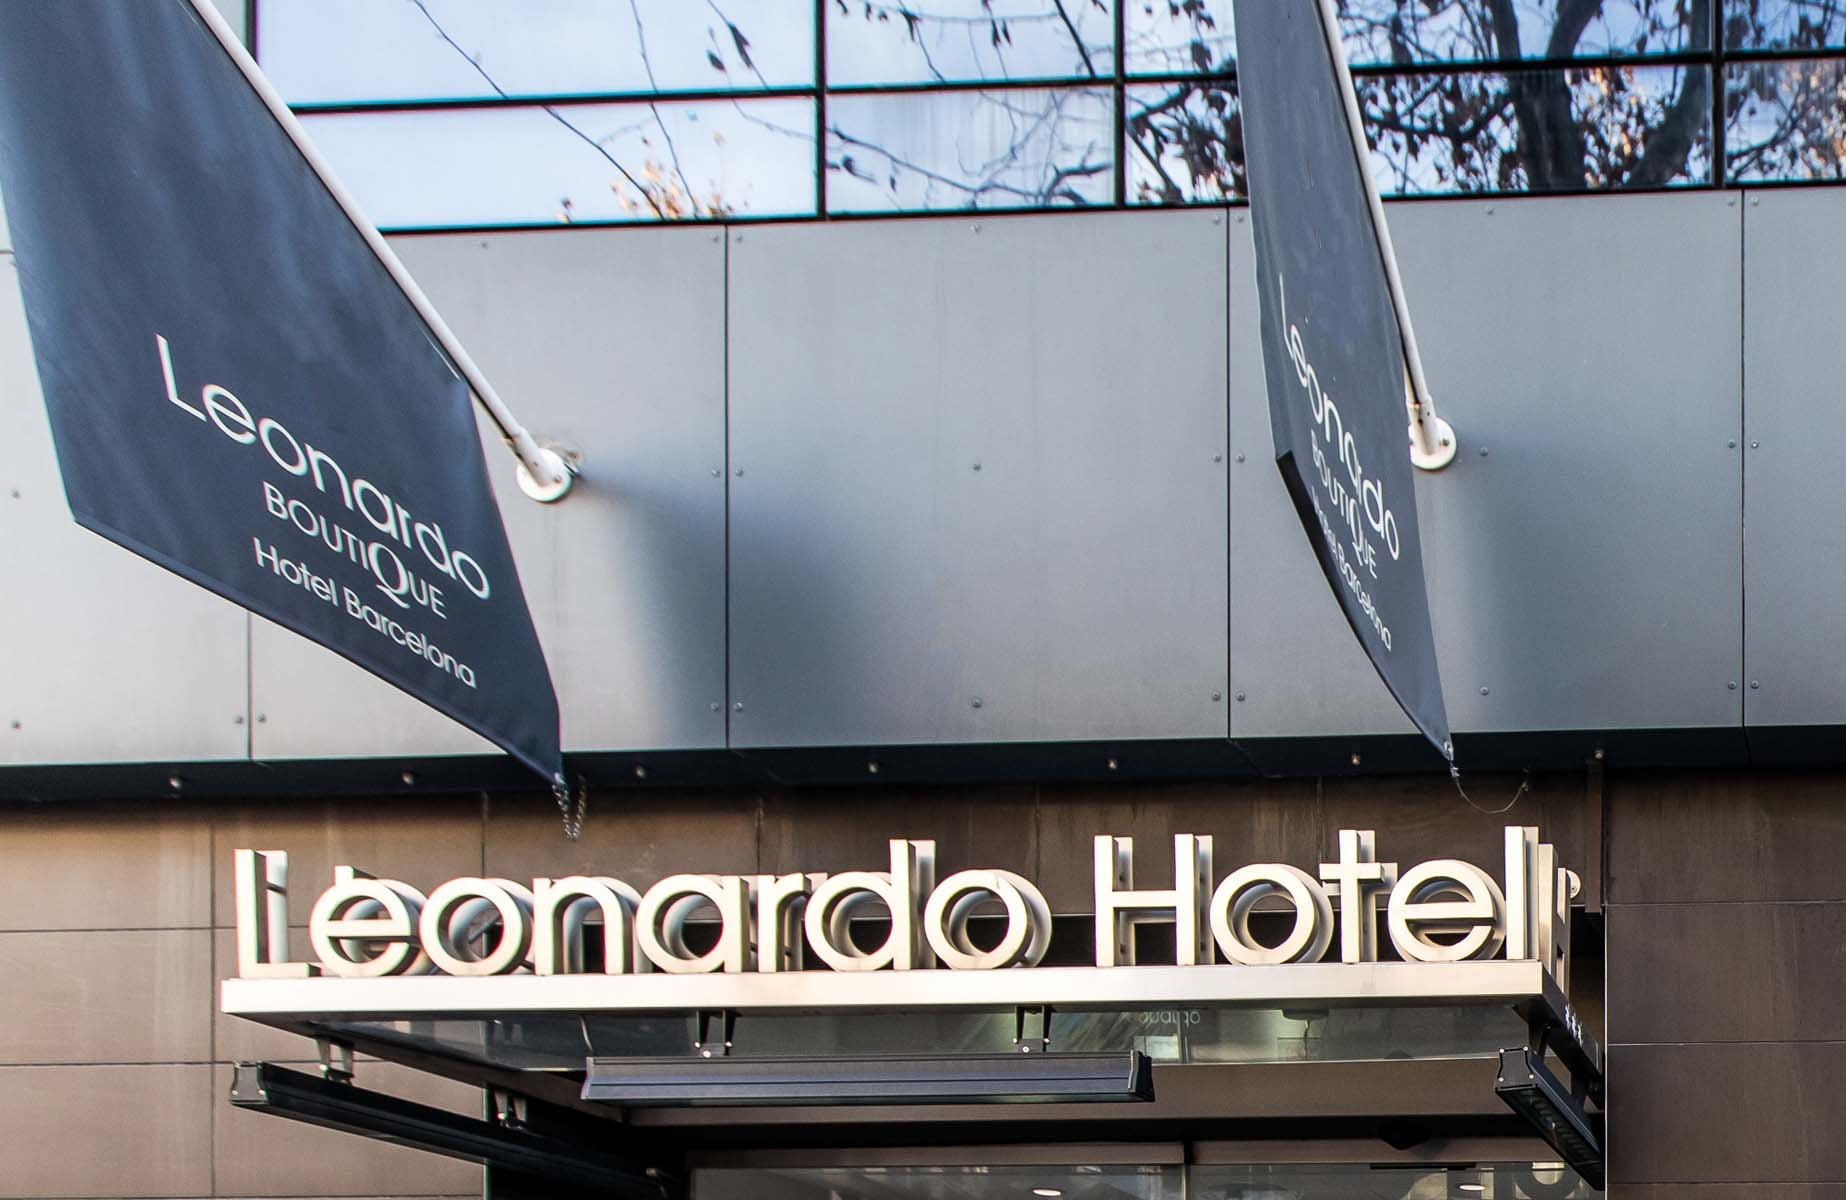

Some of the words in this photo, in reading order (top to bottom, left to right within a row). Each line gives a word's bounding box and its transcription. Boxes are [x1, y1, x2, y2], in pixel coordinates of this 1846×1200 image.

[155, 332, 491, 601] Leonardo
[1278, 271, 1400, 561] Leonardo
[262, 480, 449, 621] BOUTIQUE
[1310, 428, 1378, 580] BOUTIQUE
[253, 536, 338, 607] Hotel
[344, 585, 478, 690] Barcelona
[234, 838, 1030, 979] Leonardo
[1092, 825, 1526, 967] Hotel
